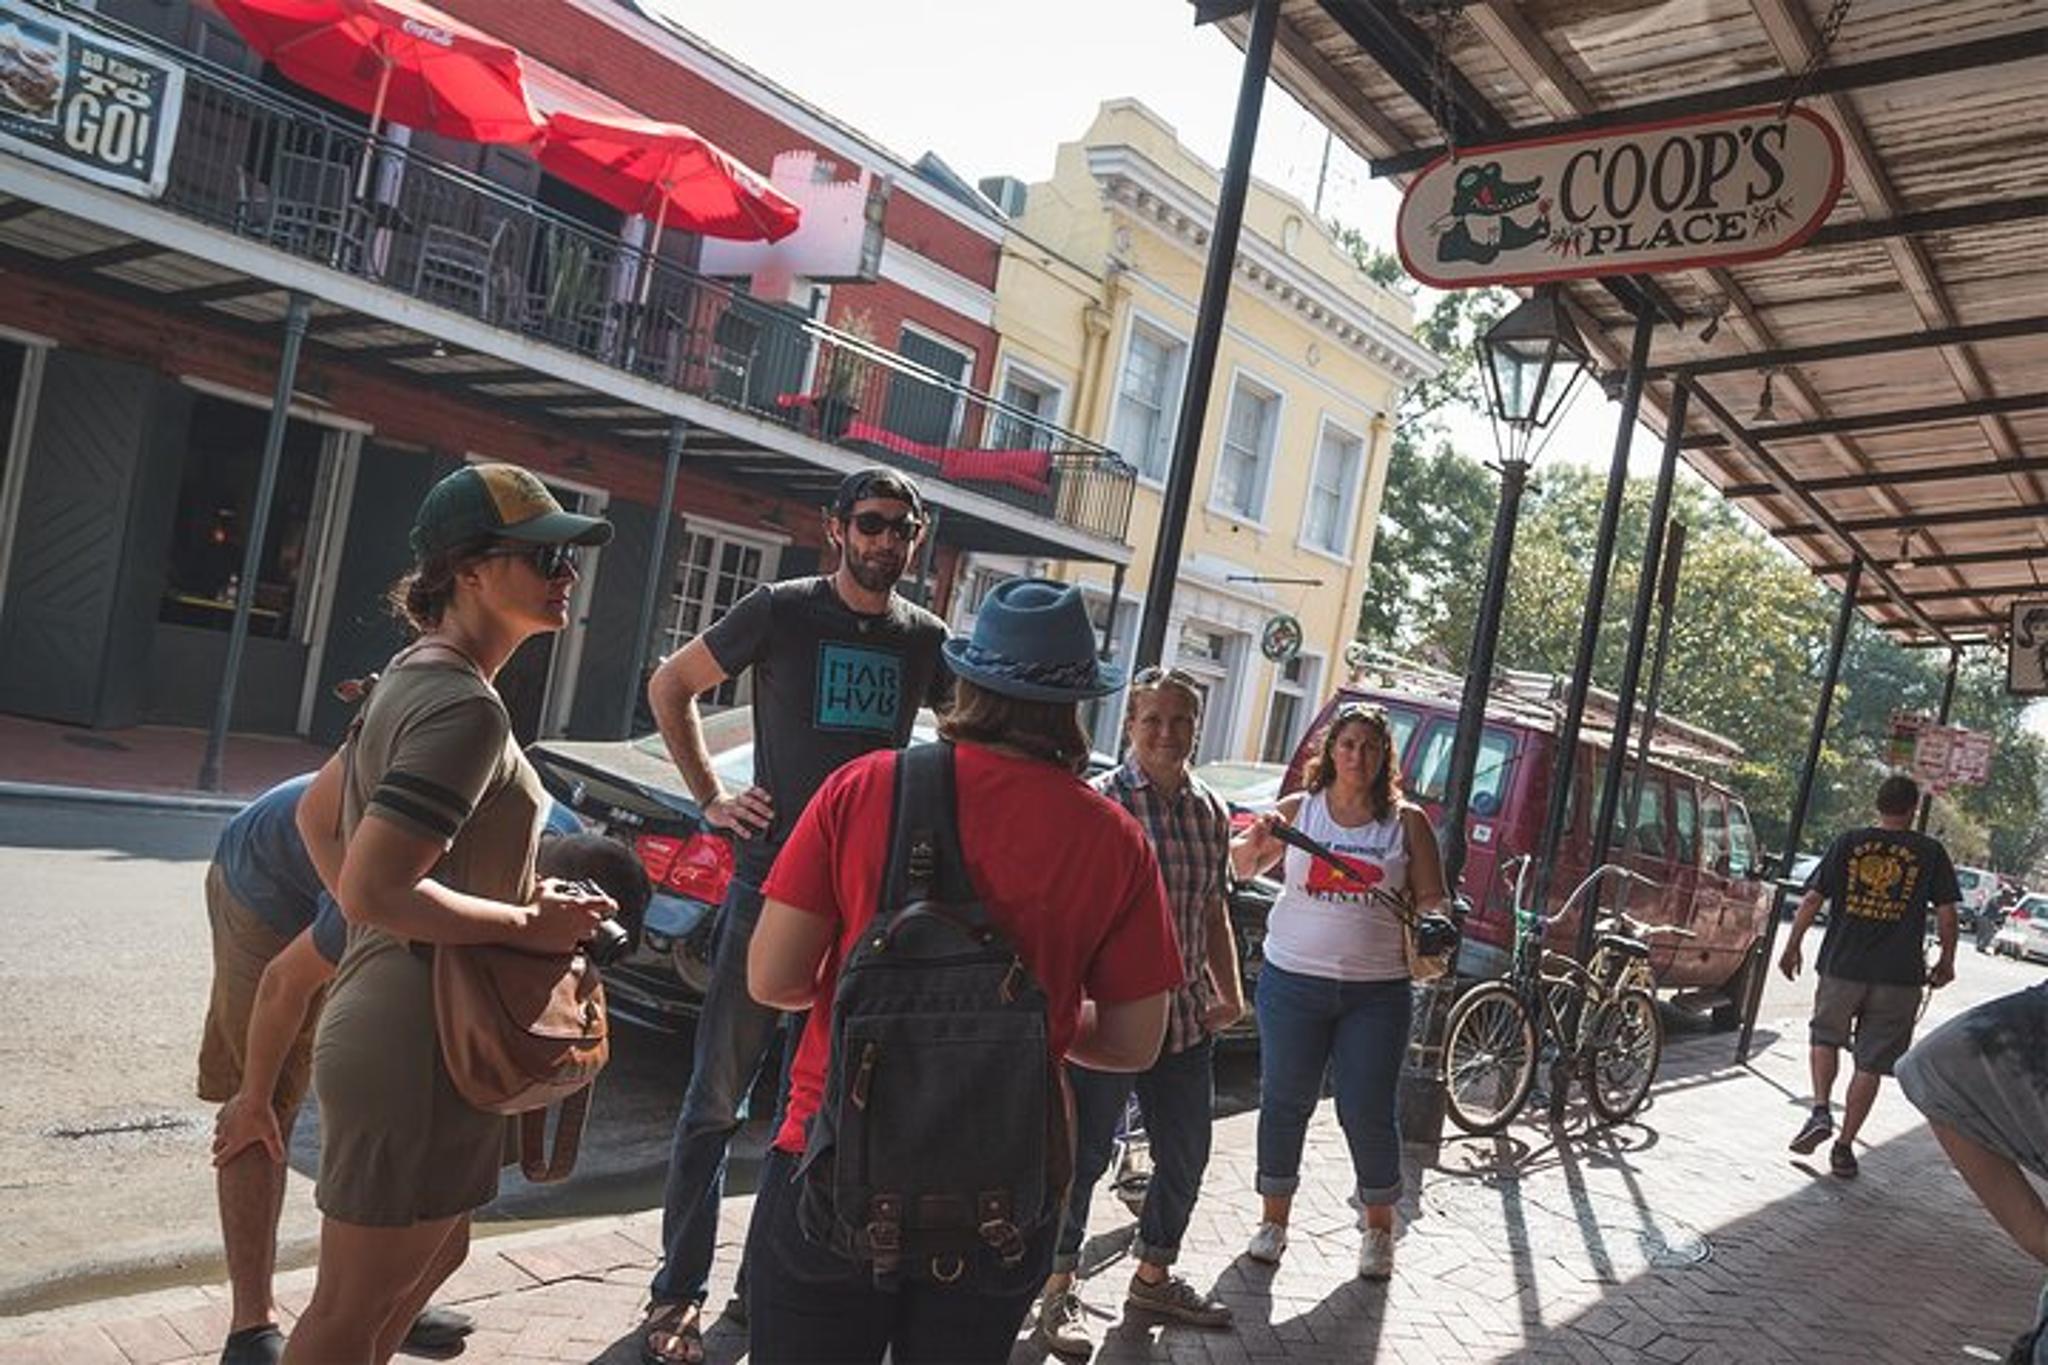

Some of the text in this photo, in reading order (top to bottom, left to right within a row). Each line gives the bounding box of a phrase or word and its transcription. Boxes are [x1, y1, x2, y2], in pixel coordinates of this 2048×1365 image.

[79, 68, 152, 108] TO
[65, 92, 149, 170] GO!
[1560, 123, 1788, 224] COOP'S
[1584, 211, 1748, 256] PLACE
